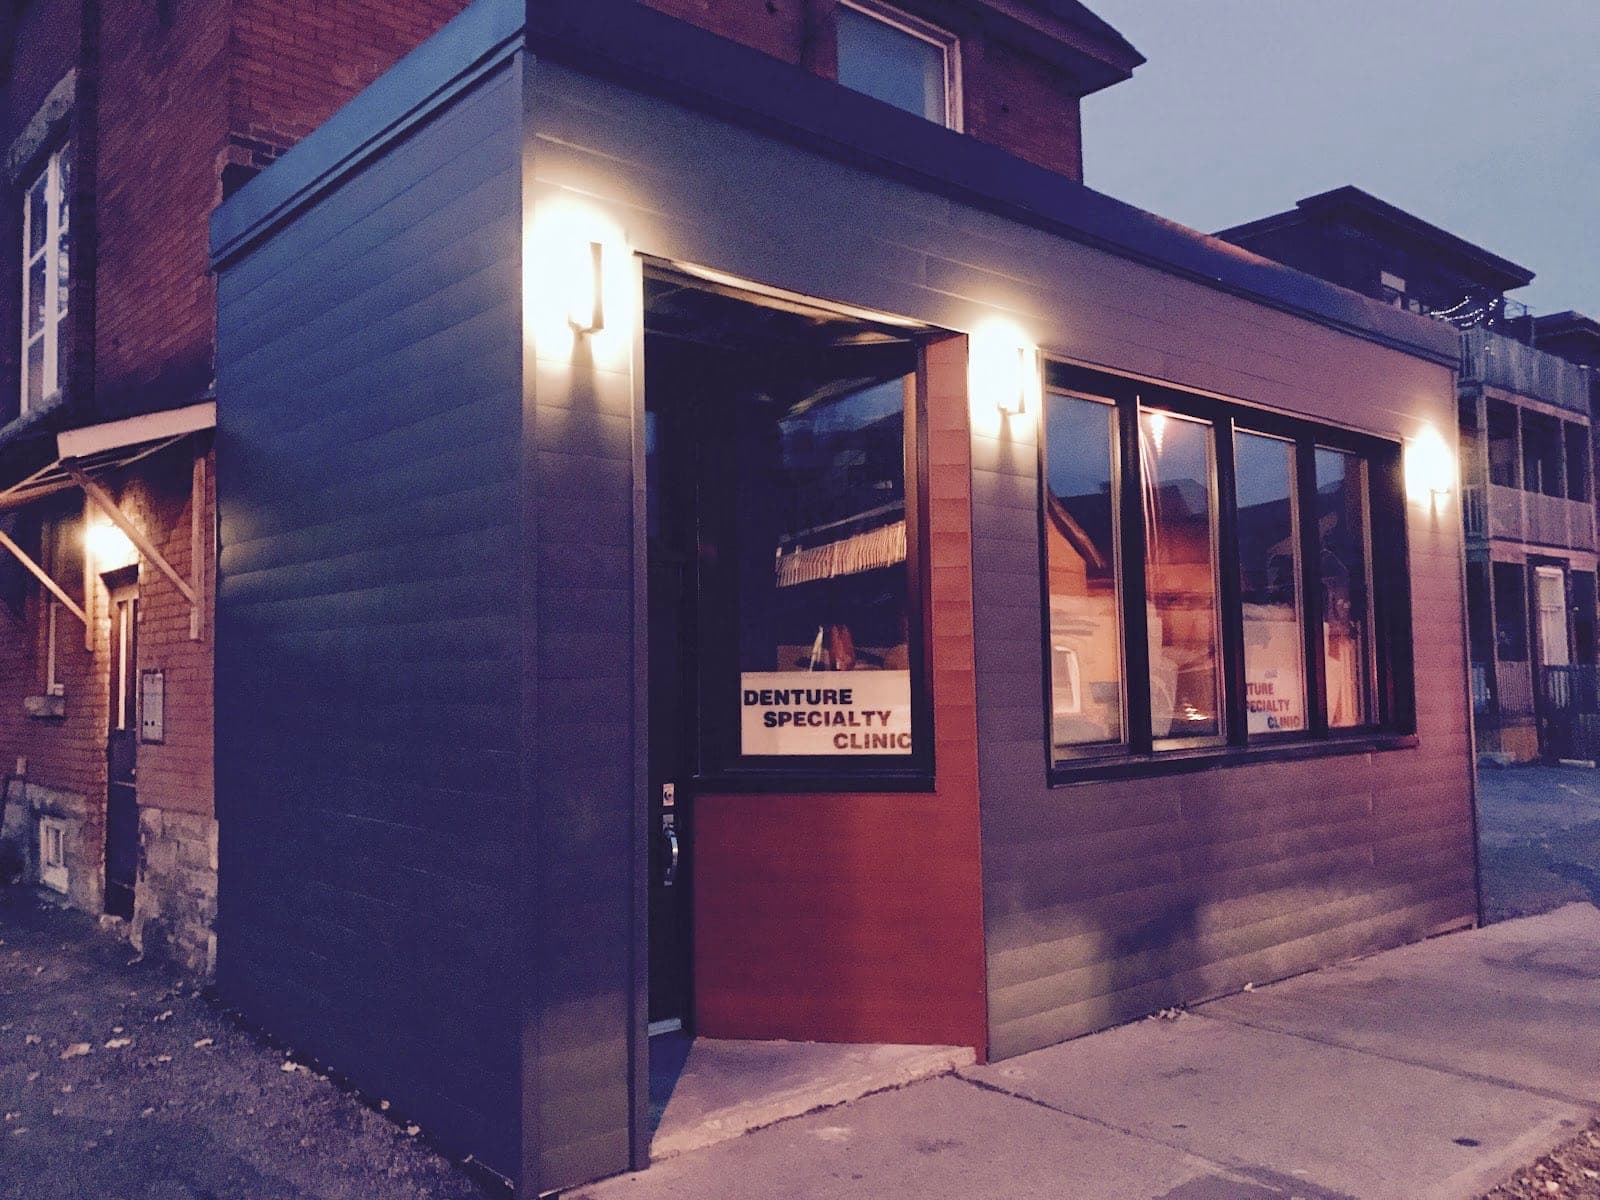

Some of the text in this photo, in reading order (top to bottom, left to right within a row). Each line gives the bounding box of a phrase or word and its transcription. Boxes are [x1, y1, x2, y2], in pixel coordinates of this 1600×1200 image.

[1246, 682, 1274, 695] TURE
[743, 689, 853, 706] DENTURE
[763, 710, 892, 728] SPECIALTY
[1267, 715, 1300, 729] CLINIC
[833, 732, 912, 750] CLINIC
